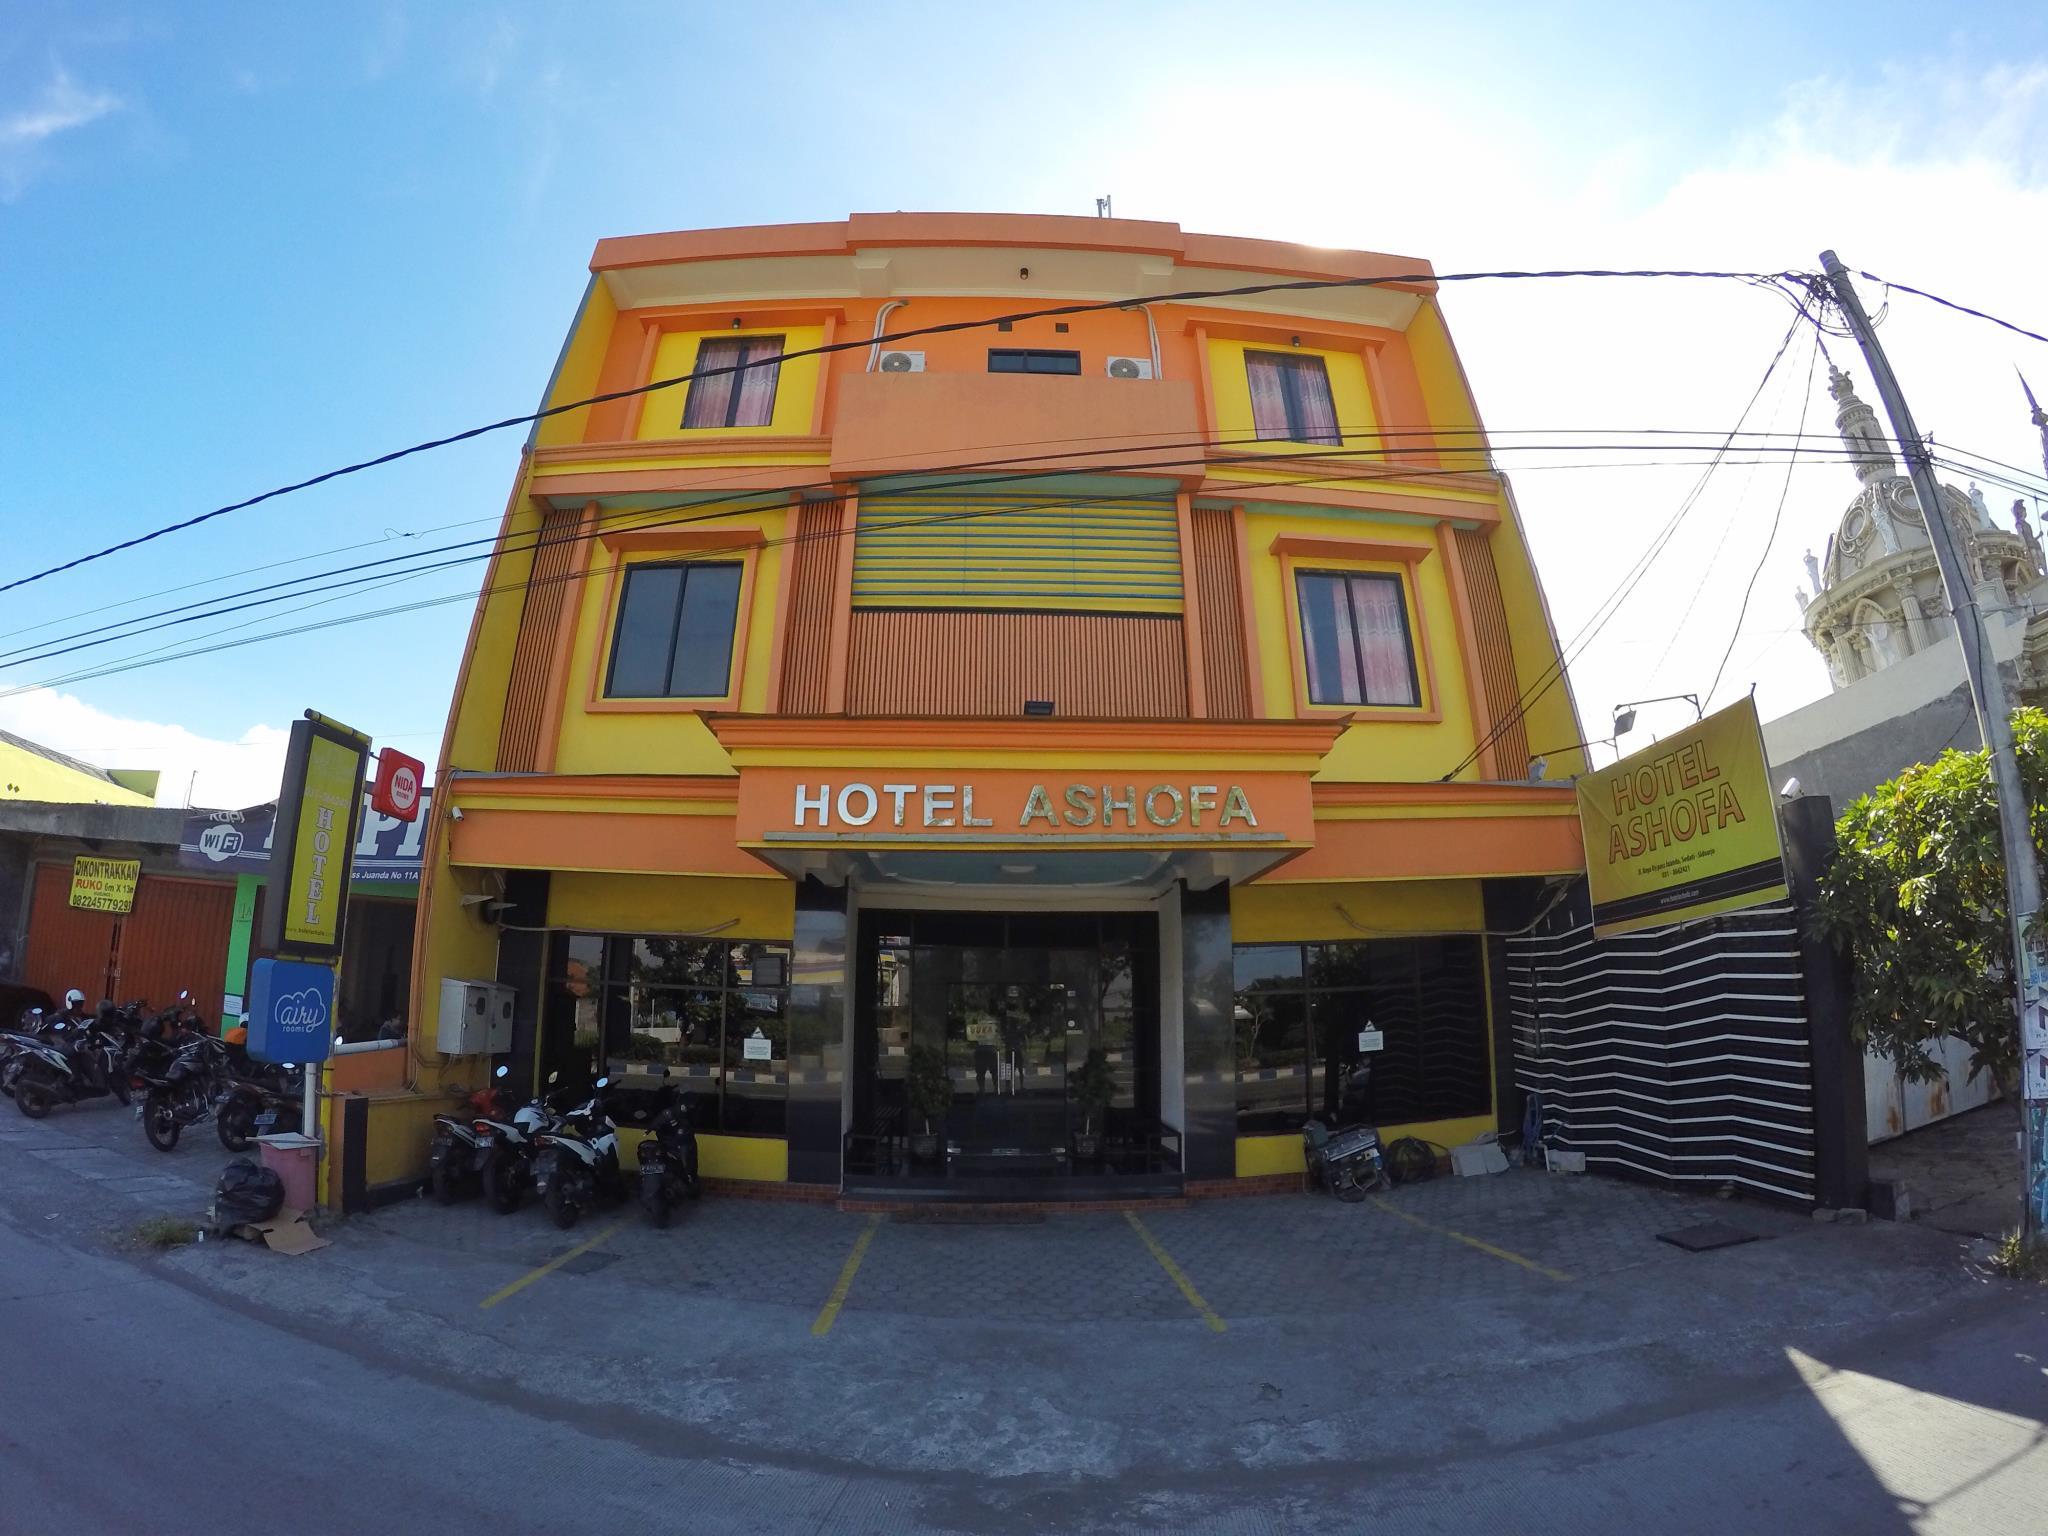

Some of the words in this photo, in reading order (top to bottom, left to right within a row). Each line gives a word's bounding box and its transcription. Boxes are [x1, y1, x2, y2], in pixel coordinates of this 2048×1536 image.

[395, 775, 413, 794] NIDA
[1611, 740, 1720, 816] HOTEL
[793, 783, 993, 827] HOTEL
[1019, 783, 1259, 827] ASHOFA
[1608, 782, 1746, 865] ASHOFA
[75, 860, 138, 880] DIKONTRAKKAN
[306, 806, 335, 924] HOTEL
[362, 871, 389, 879] Juanda
[391, 871, 402, 879] No
[404, 871, 419, 880] 11A
[75, 879, 102, 891] RUKO
[280, 999, 318, 1033] airy
[282, 1025, 304, 1033] rooms
